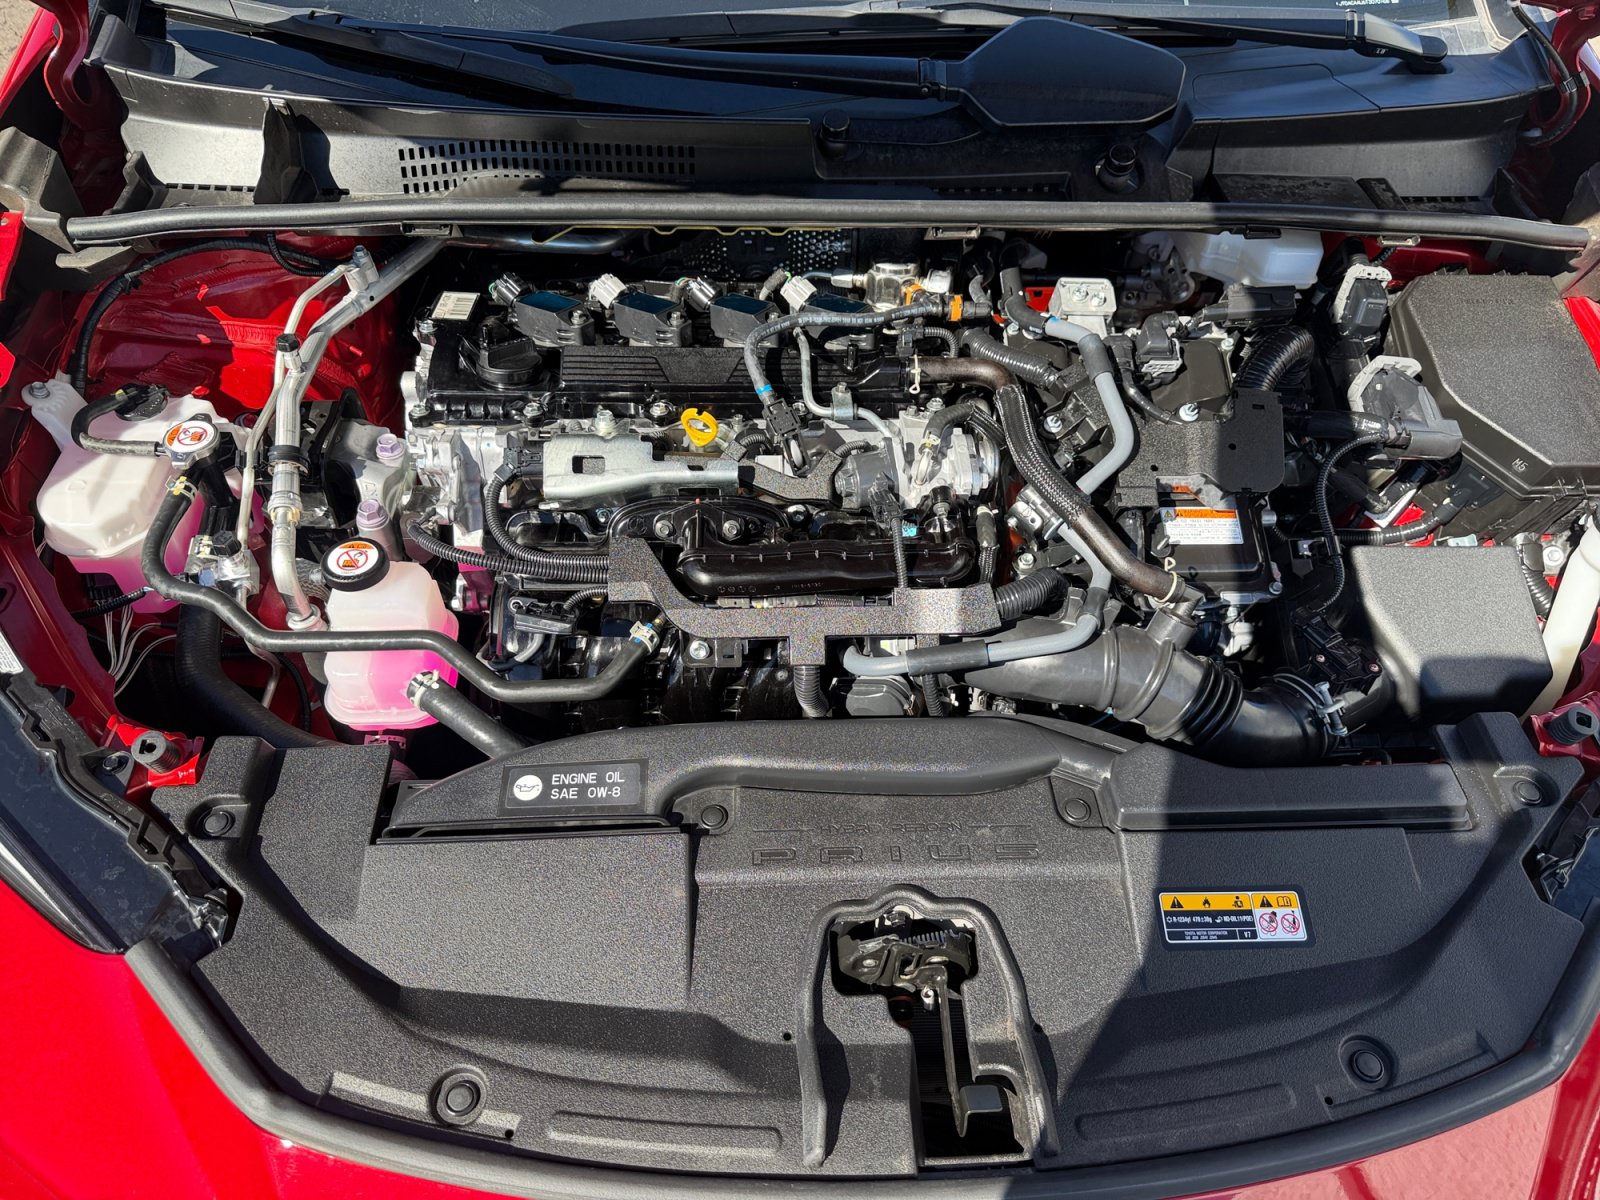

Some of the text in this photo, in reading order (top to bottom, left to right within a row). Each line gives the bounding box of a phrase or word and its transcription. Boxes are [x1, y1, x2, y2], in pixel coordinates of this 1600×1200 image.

[551, 771, 625, 785] ENGINE OIL
[550, 786, 621, 800] SAE 0W-8
[891, 822, 962, 833] REBORN
[752, 842, 1039, 866] PRIUS
